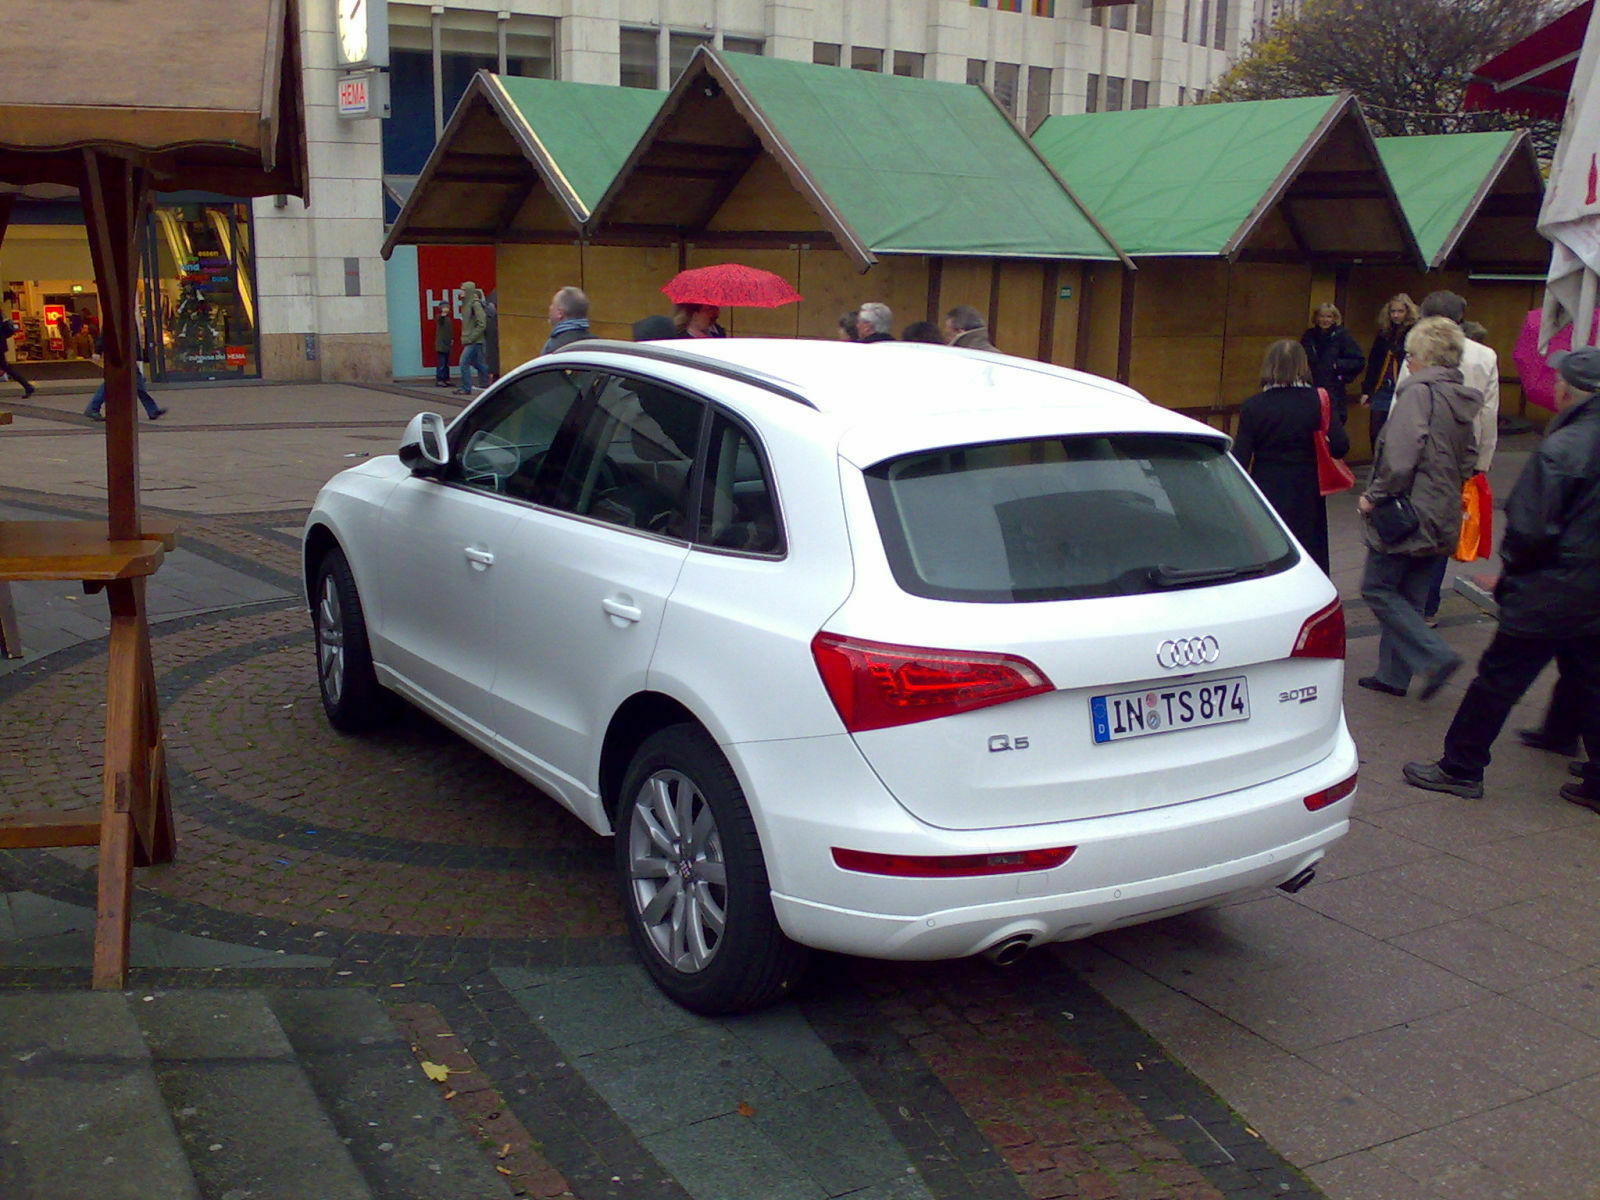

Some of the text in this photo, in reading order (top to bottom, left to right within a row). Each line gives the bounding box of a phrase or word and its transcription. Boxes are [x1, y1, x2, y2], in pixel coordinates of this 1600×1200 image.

[340, 82, 366, 105] HEMA
[1113, 697, 1145, 734] IN
[1098, 724, 1106, 735] D
[988, 734, 1030, 752] Q5
